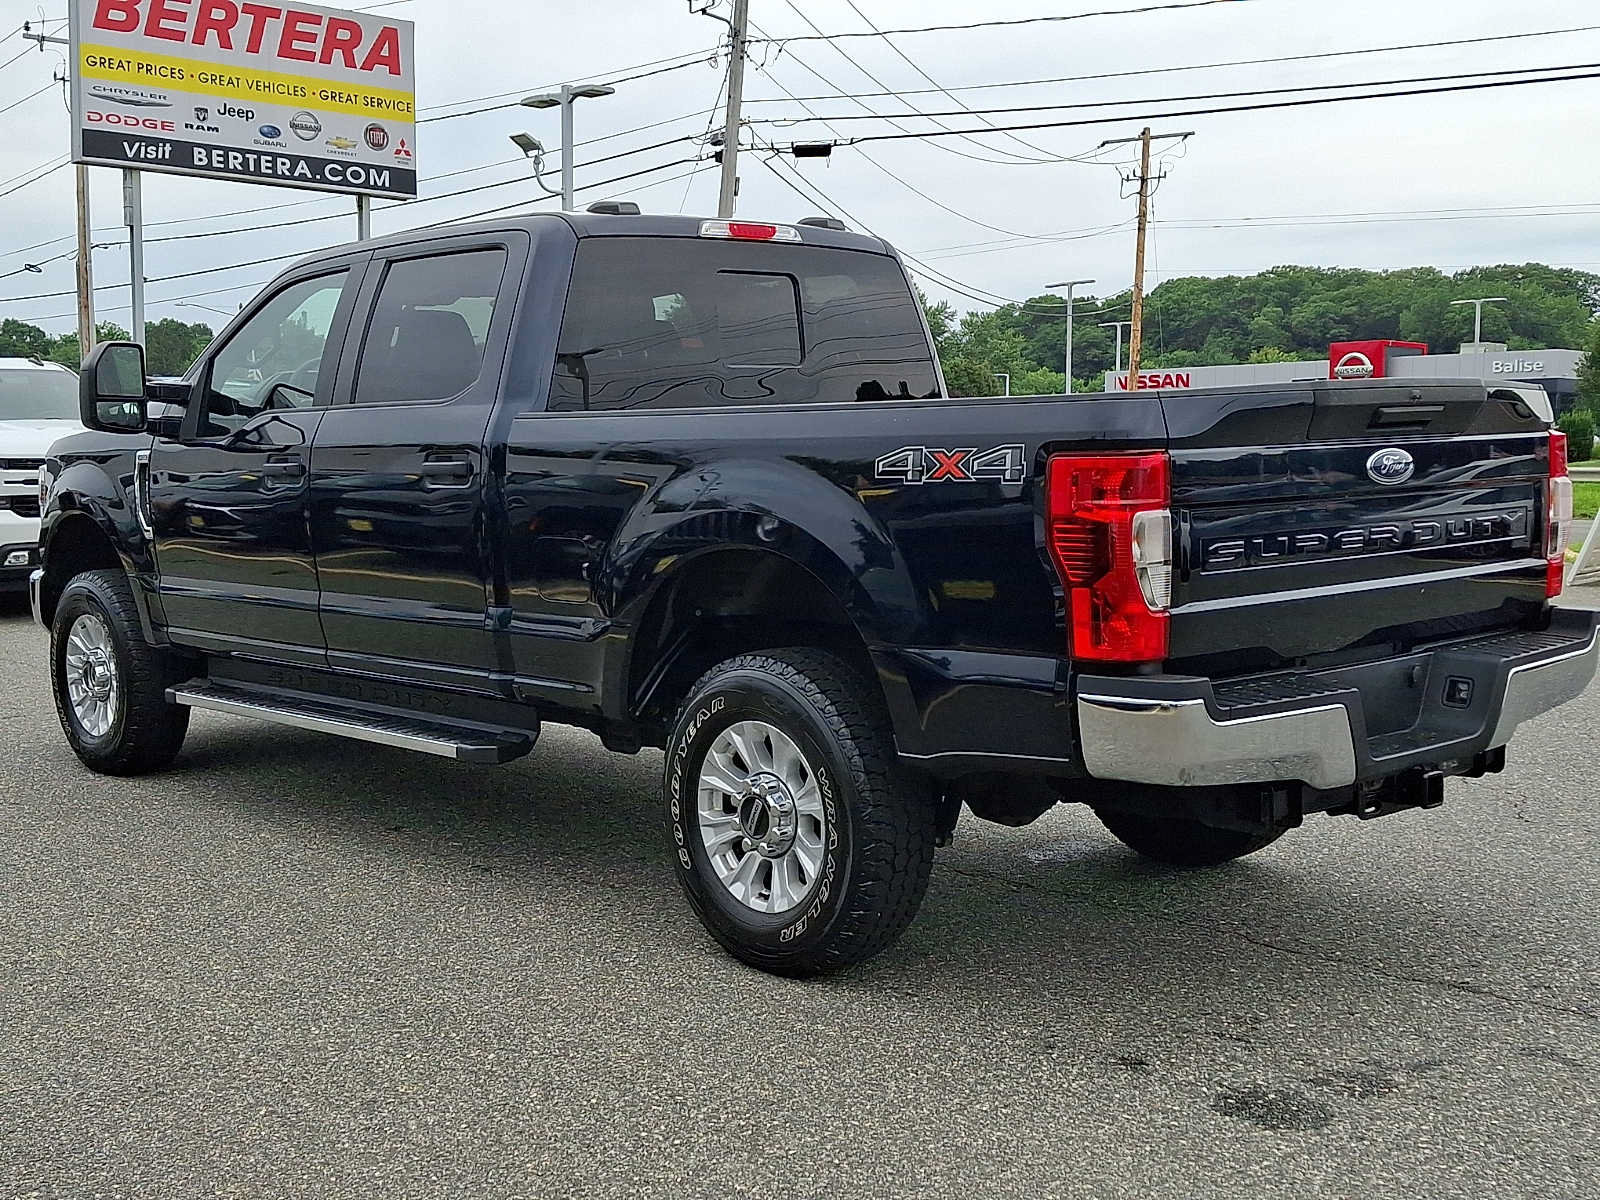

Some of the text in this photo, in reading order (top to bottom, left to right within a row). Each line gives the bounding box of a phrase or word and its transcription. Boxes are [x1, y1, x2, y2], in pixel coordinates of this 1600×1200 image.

[92, 0, 402, 76] BERTERA
[86, 55, 412, 113] GREAT PRICES GREAT VEHICLES GREAT SERVICE
[92, 85, 168, 101] CHRYSLER
[86, 111, 176, 132] DODGE
[217, 102, 255, 122] Jeep
[184, 123, 220, 133] RAM
[293, 121, 319, 131] NISSAN
[253, 138, 287, 148] SUBARU
[369, 131, 384, 145] FIAT
[123, 141, 391, 188] Visit BERTERA.COM
[1337, 367, 1369, 375] NISSAN
[1492, 358, 1544, 373] Balise
[1114, 373, 1190, 390] NSSAN
[1381, 454, 1407, 475] Ford
[1207, 511, 1525, 564] SUPER DUTY
[671, 696, 726, 870] GOODYEAR
[779, 767, 839, 942] WRANGLER
